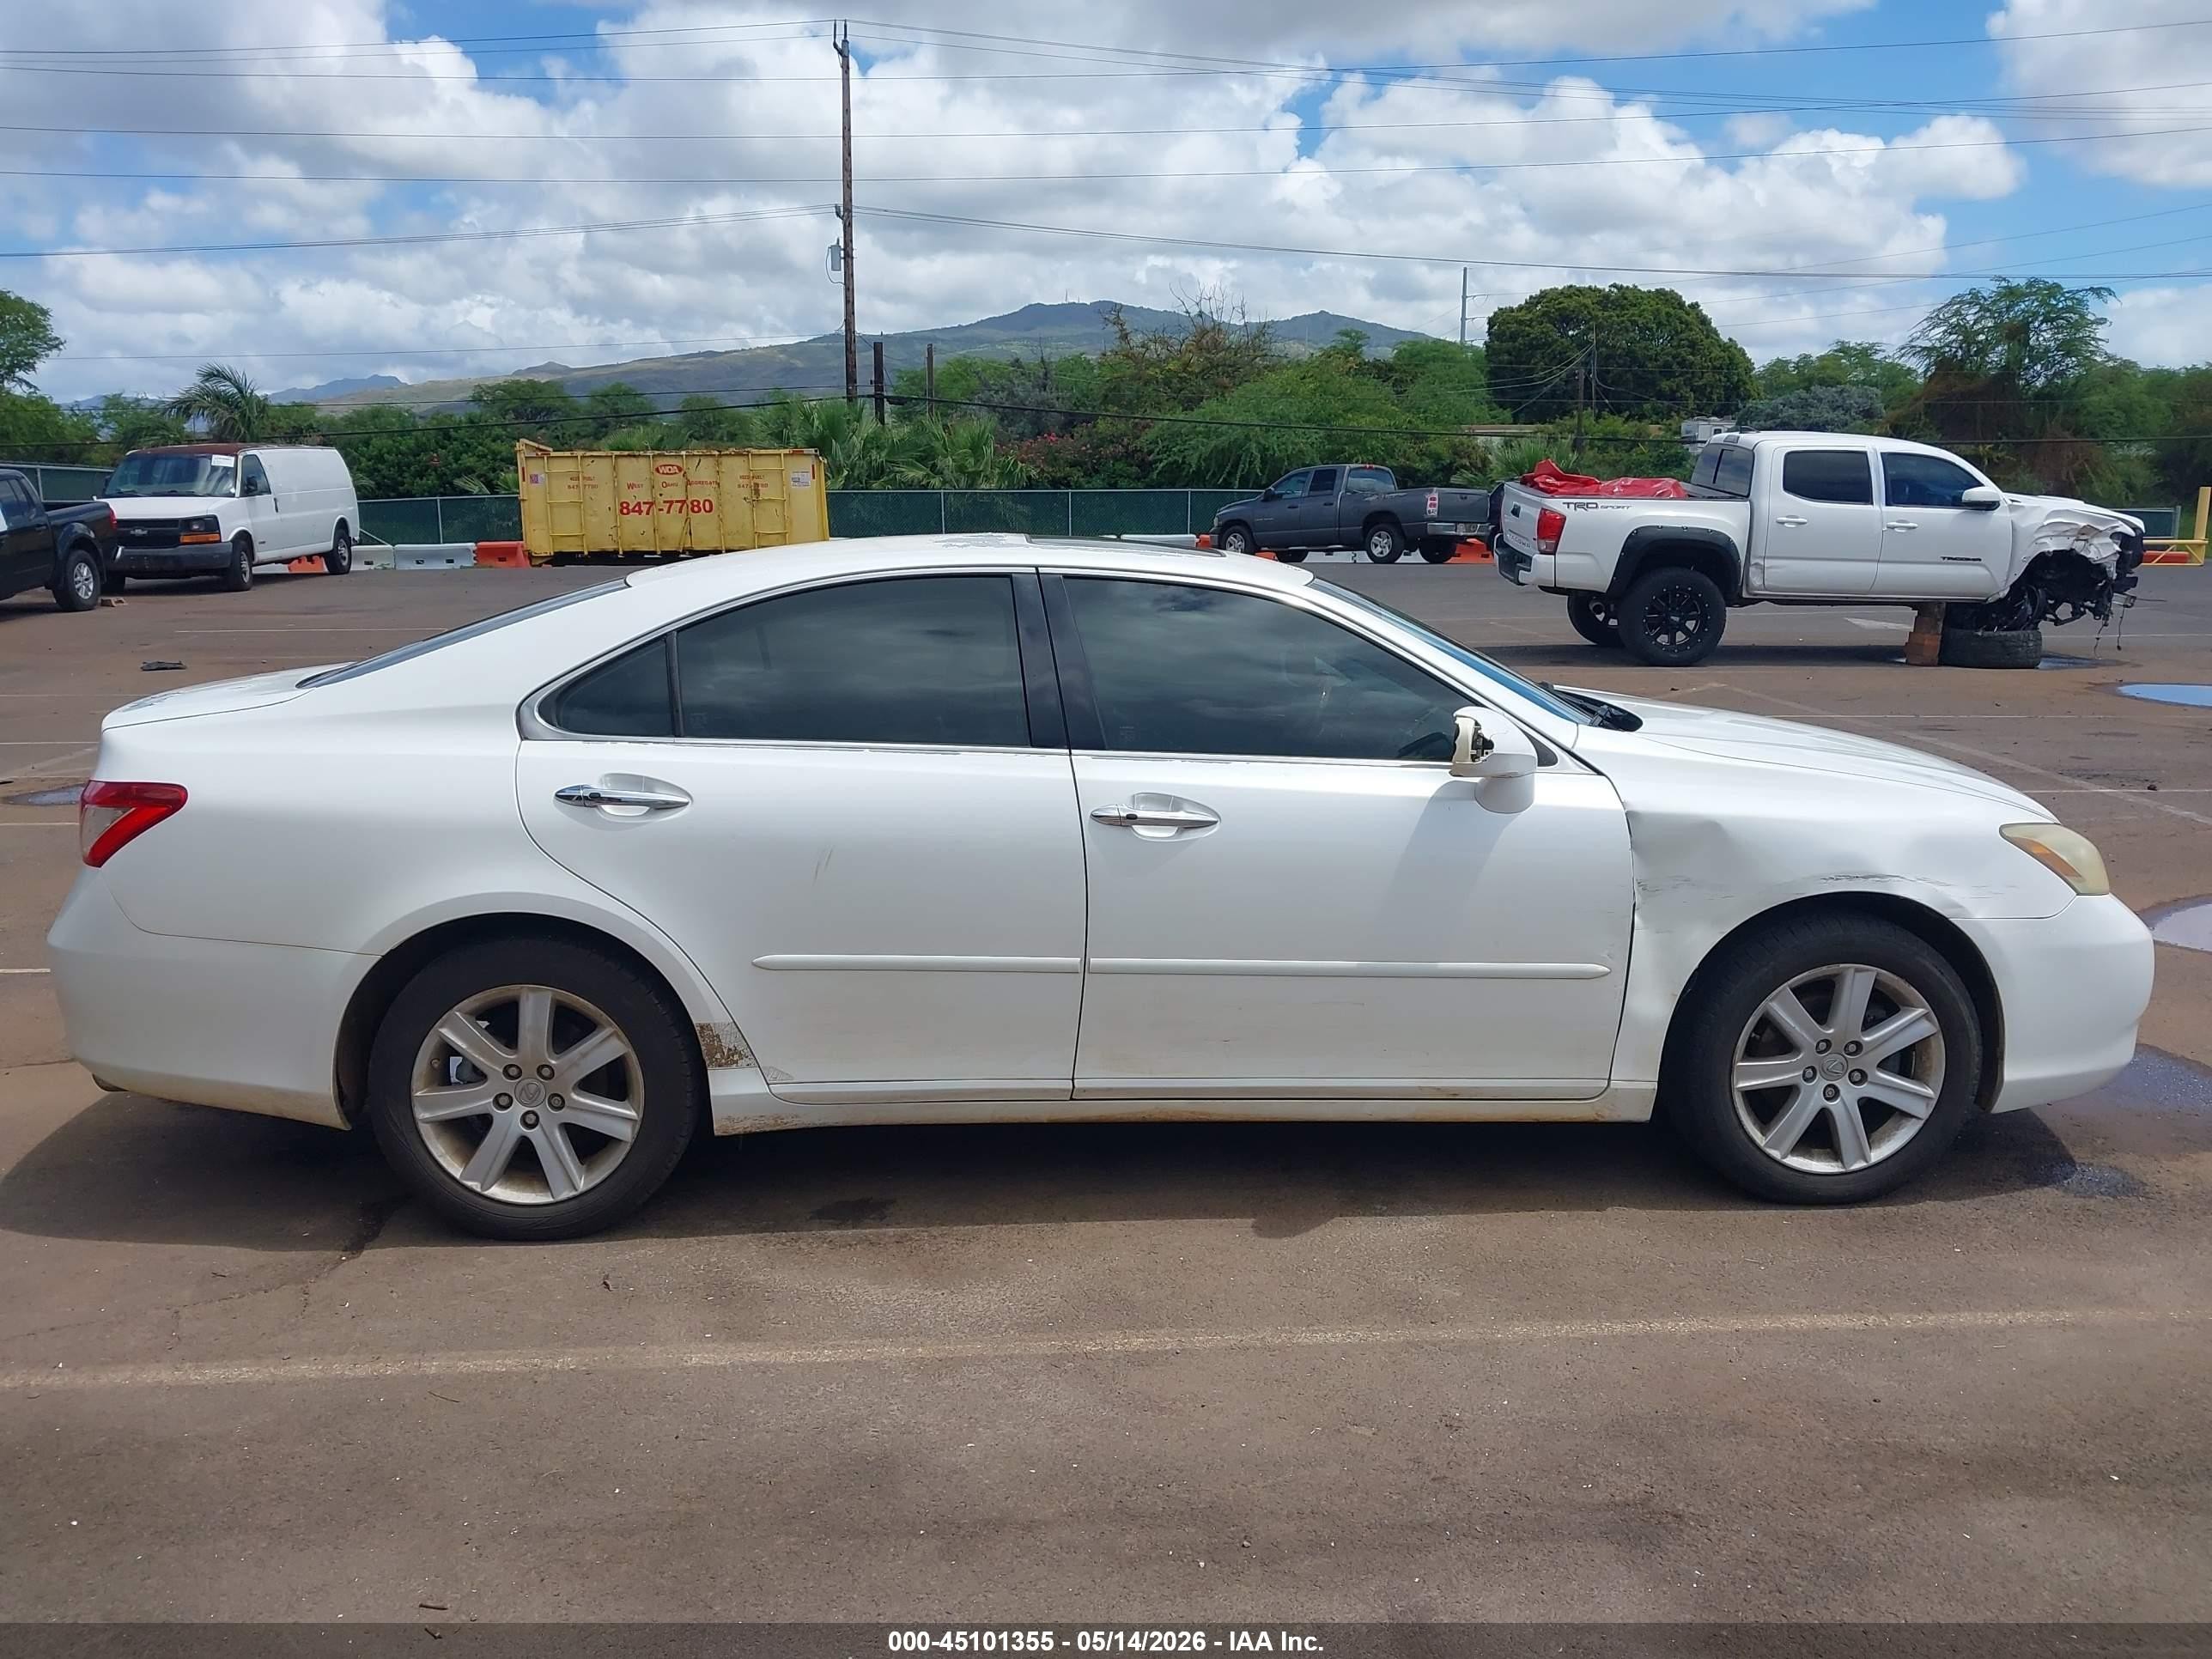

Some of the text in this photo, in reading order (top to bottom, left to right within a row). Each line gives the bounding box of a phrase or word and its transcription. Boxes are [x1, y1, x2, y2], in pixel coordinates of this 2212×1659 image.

[658, 465, 679, 474] WOA
[619, 499, 714, 515] 847-7780
[1562, 501, 1598, 512] TRD
